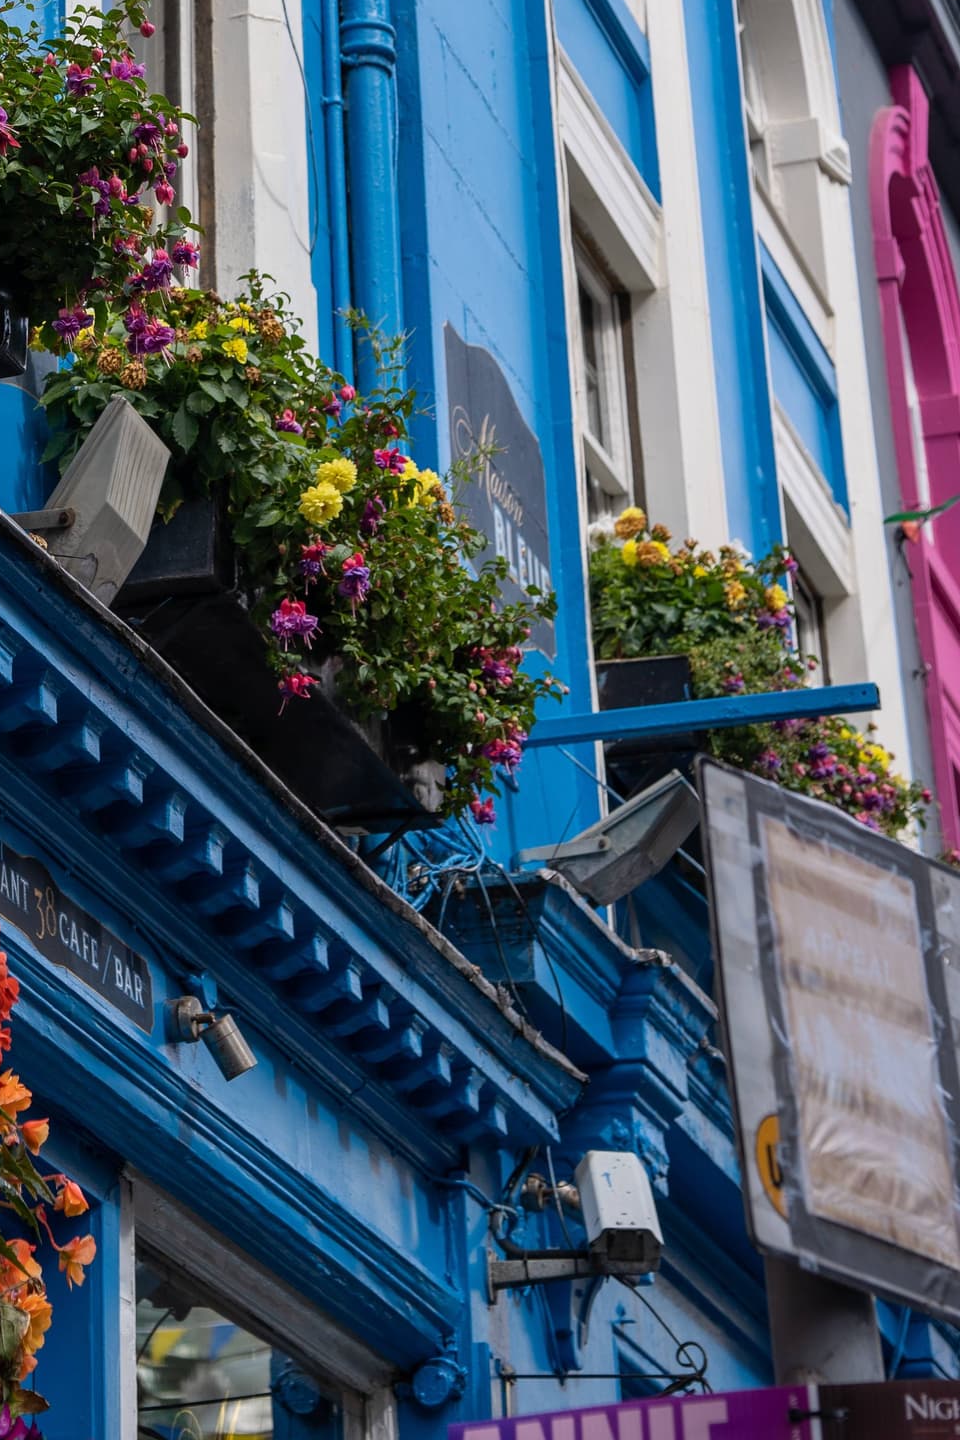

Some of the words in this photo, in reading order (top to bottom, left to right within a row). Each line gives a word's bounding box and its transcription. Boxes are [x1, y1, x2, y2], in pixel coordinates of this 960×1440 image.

[451, 406, 524, 528] Maison
[34, 886, 57, 940] 38
[58, 912, 100, 970] CAFE
[112, 954, 144, 1009] BAR
